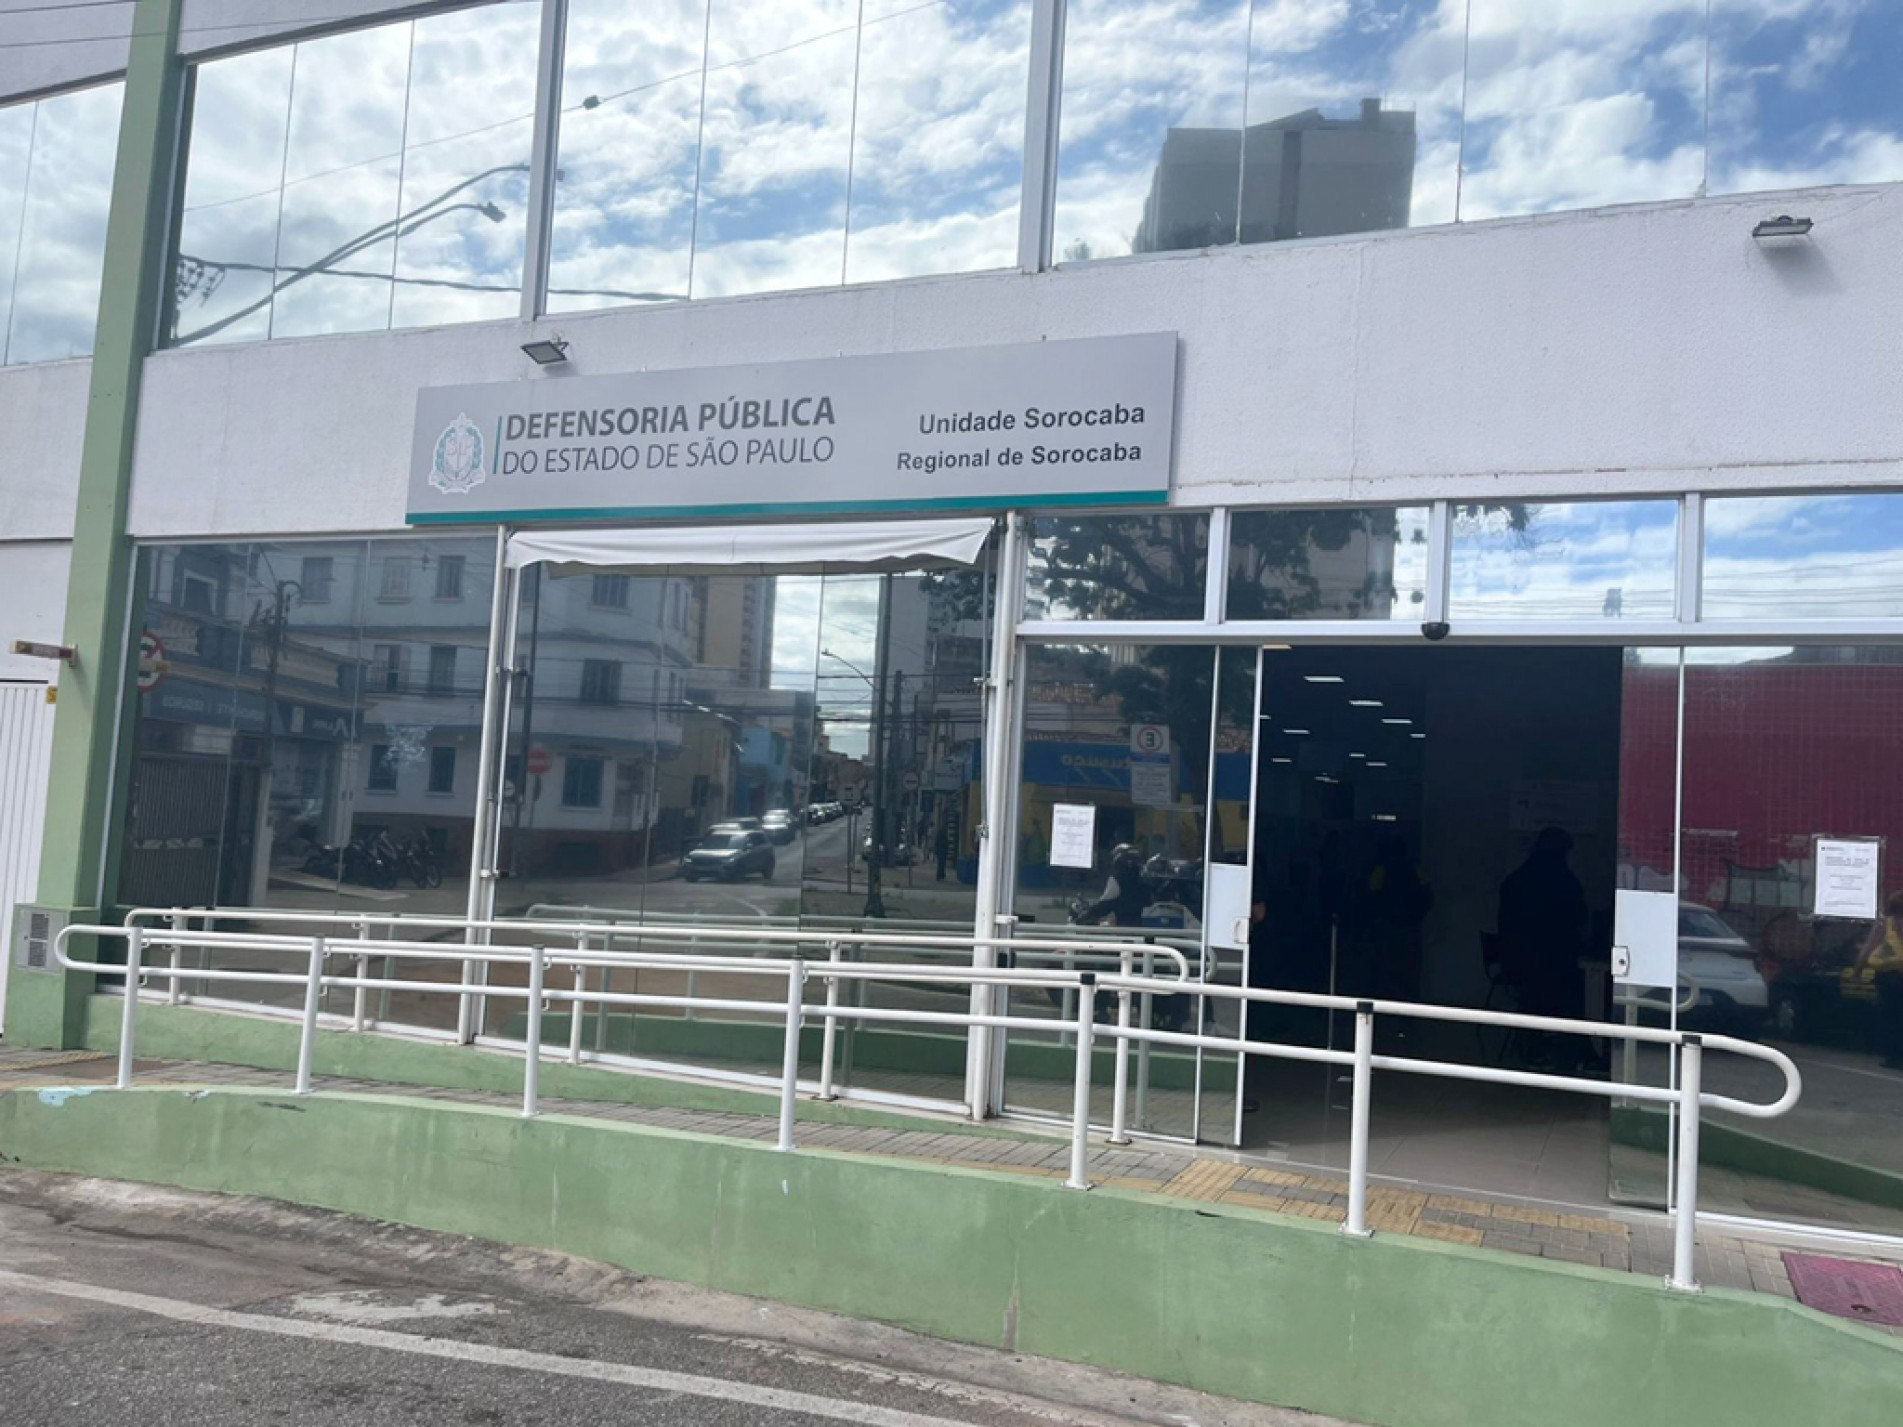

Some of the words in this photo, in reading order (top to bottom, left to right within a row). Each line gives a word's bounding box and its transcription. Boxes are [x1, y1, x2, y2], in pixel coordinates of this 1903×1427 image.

[505, 404, 689, 441] DEFENSORIA
[698, 395, 835, 431] PÚBLICA
[919, 410, 1016, 434] Unidade
[1024, 403, 1145, 429] Sorocaba
[502, 449, 538, 475] DO
[544, 445, 640, 473] ESTADO
[646, 442, 680, 469] DE
[685, 436, 739, 467] SÃO
[746, 435, 835, 465] PAULO
[896, 448, 990, 474] Regional
[997, 448, 1023, 466] de
[1031, 442, 1142, 465] Sorocaba
